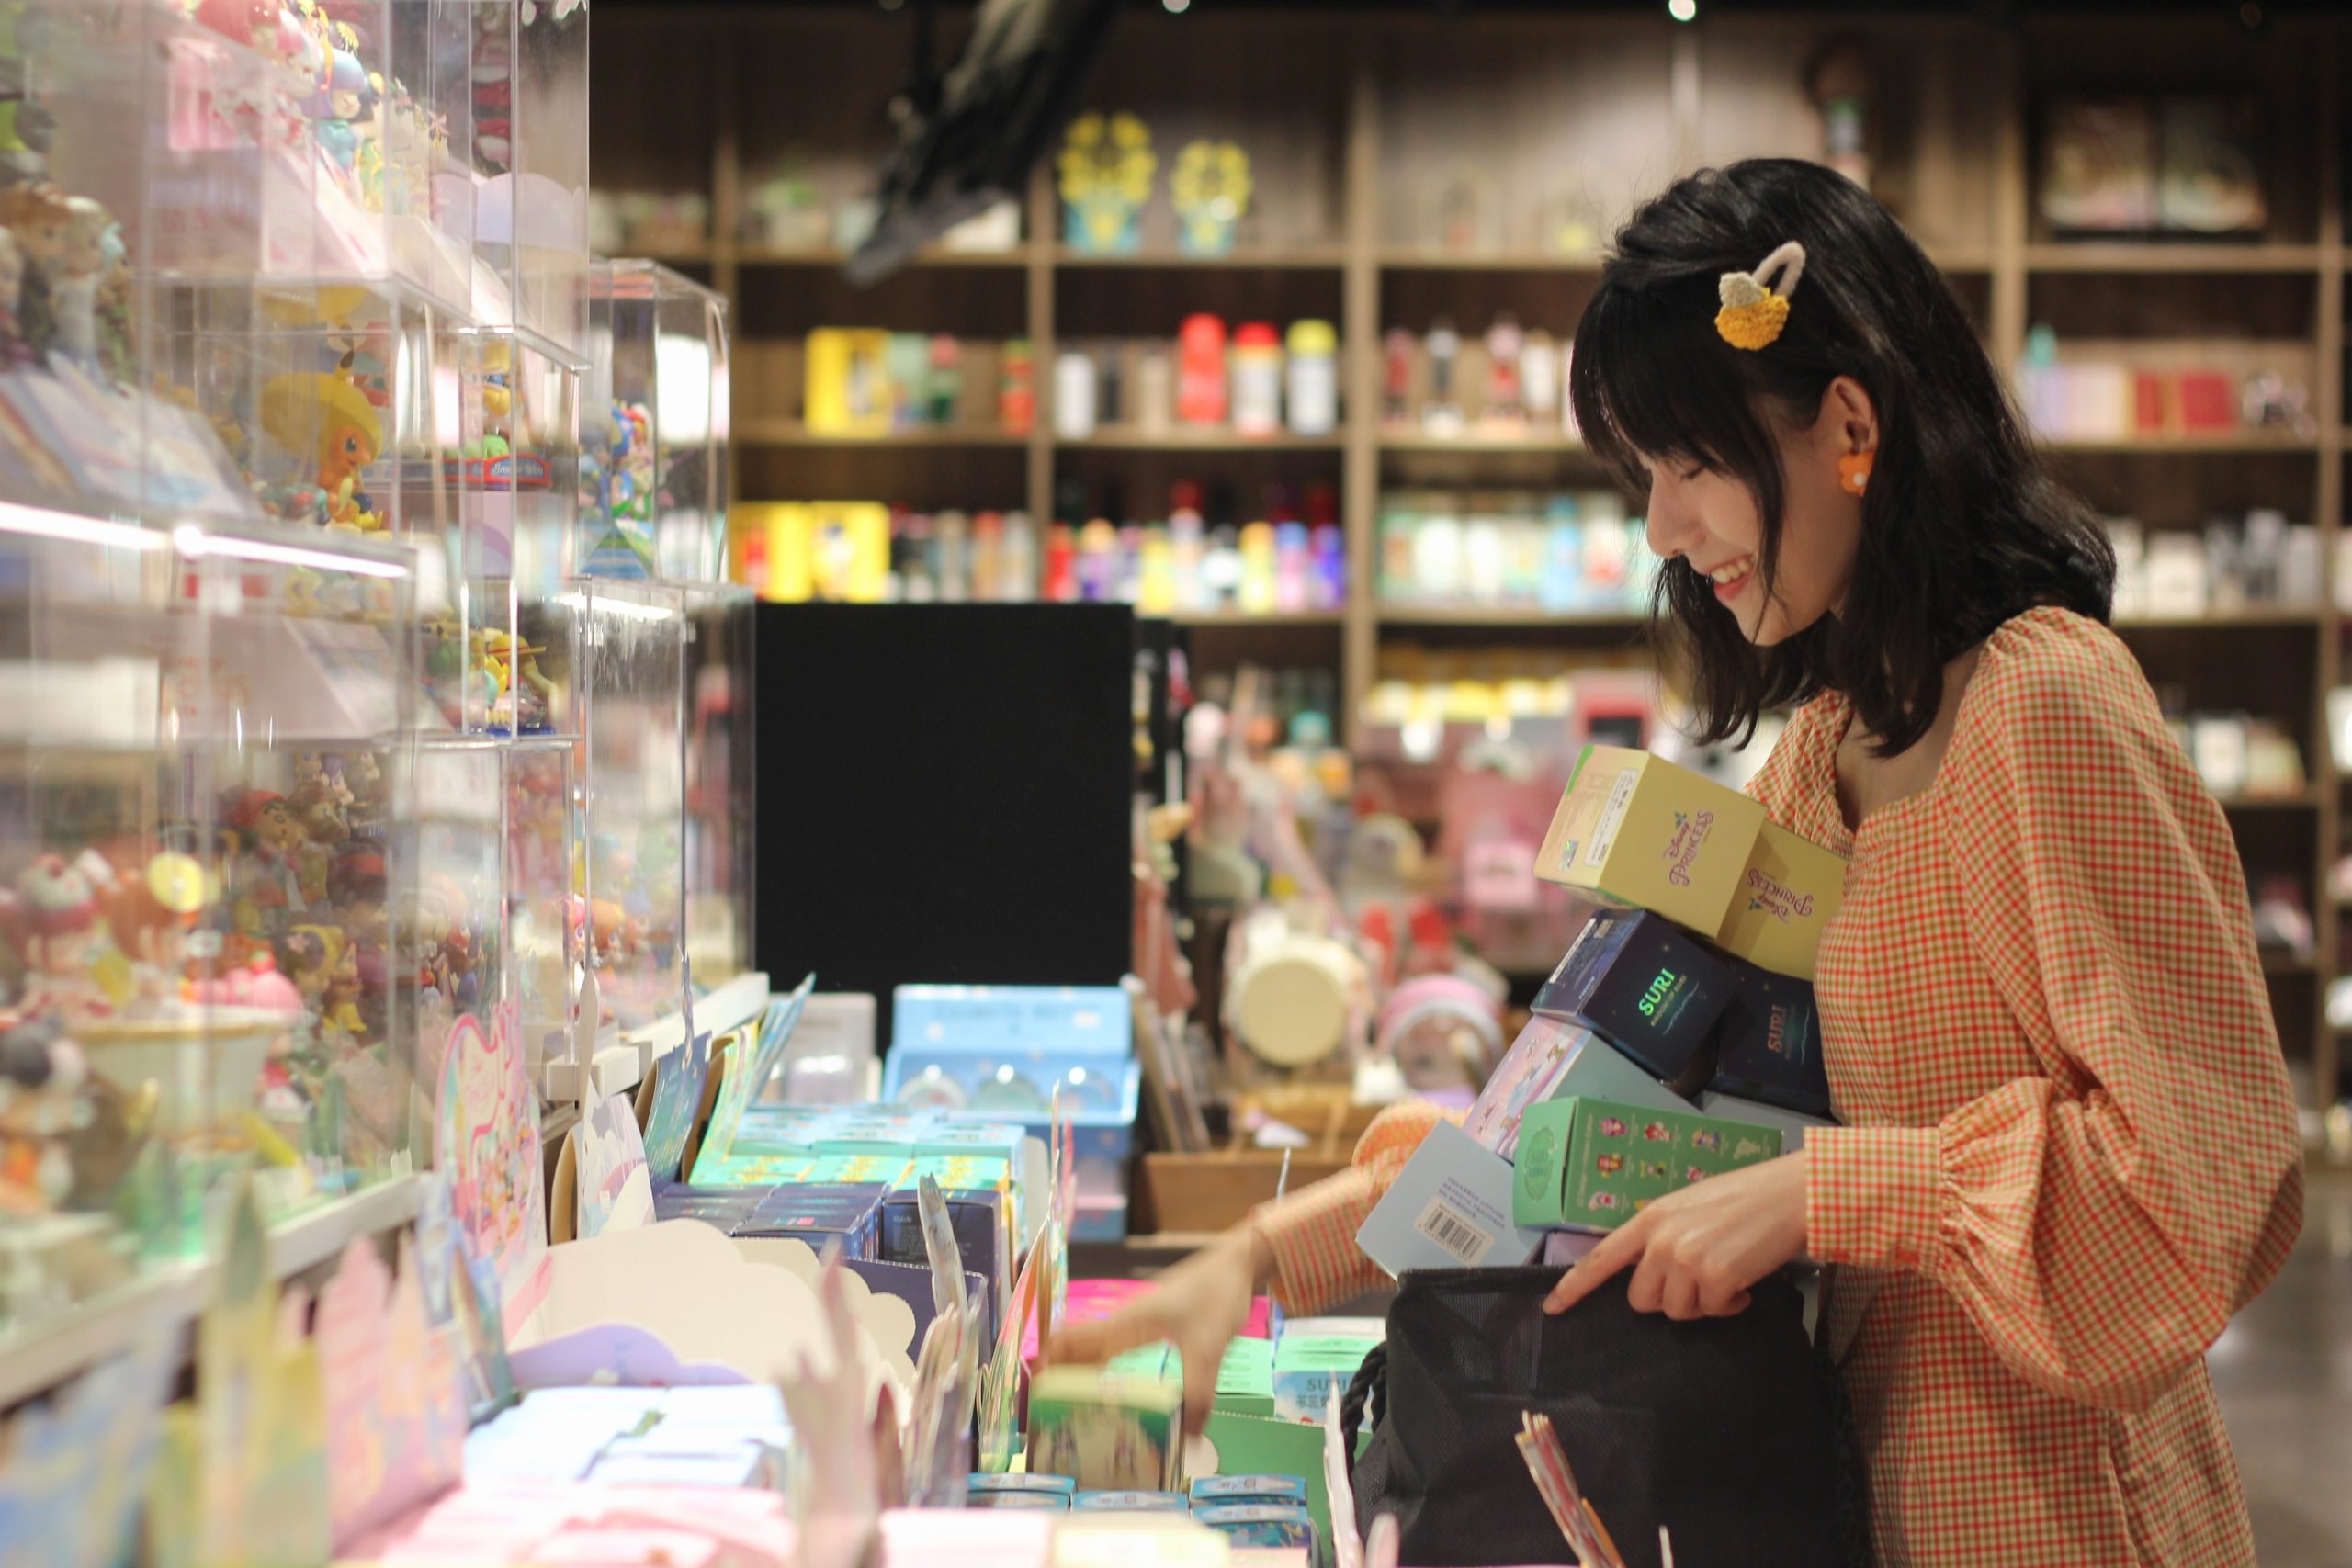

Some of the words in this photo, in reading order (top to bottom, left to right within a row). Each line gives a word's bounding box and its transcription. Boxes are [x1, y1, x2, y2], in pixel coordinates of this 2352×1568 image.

[1662, 822, 1691, 859] Disney
[1757, 891, 1790, 925] Disney
[1638, 967, 1676, 1017] SURI
[1767, 1003, 1786, 1054] SURI
[1306, 1377, 1347, 1393] SUI
